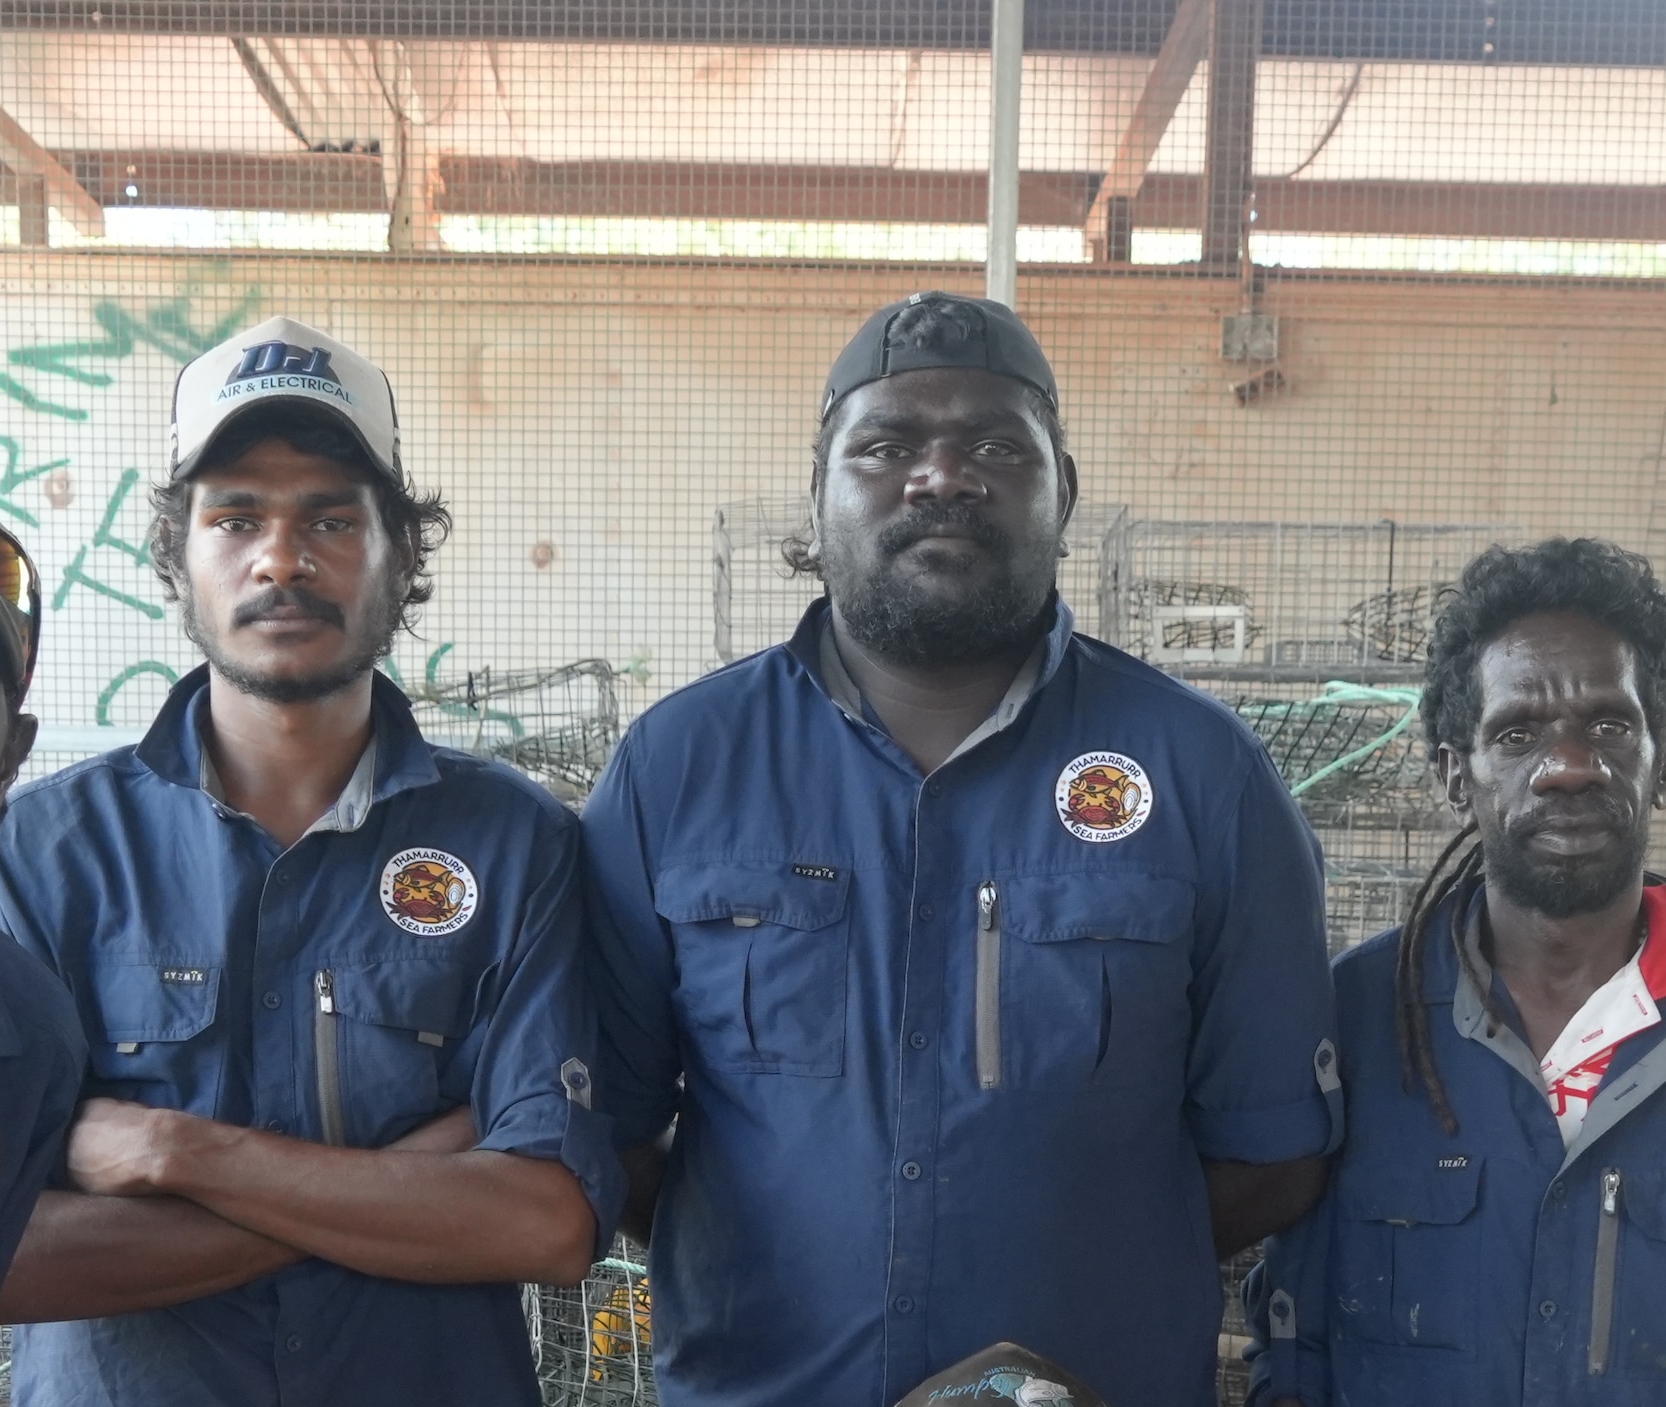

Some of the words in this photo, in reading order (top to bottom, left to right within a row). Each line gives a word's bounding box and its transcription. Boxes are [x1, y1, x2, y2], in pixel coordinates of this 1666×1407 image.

[217, 383, 241, 401] AIR
[245, 382, 256, 392] &
[261, 376, 353, 405] ELECTRICAL
[1068, 755, 1141, 779] THAMARRURR
[1073, 826, 1093, 841] SEA
[1095, 818, 1142, 841] FARMERS
[392, 851, 464, 875] THAMARRURR
[399, 918, 420, 933] SEA
[422, 912, 468, 935] FARMERS
[164, 970, 203, 981] SYZMIK
